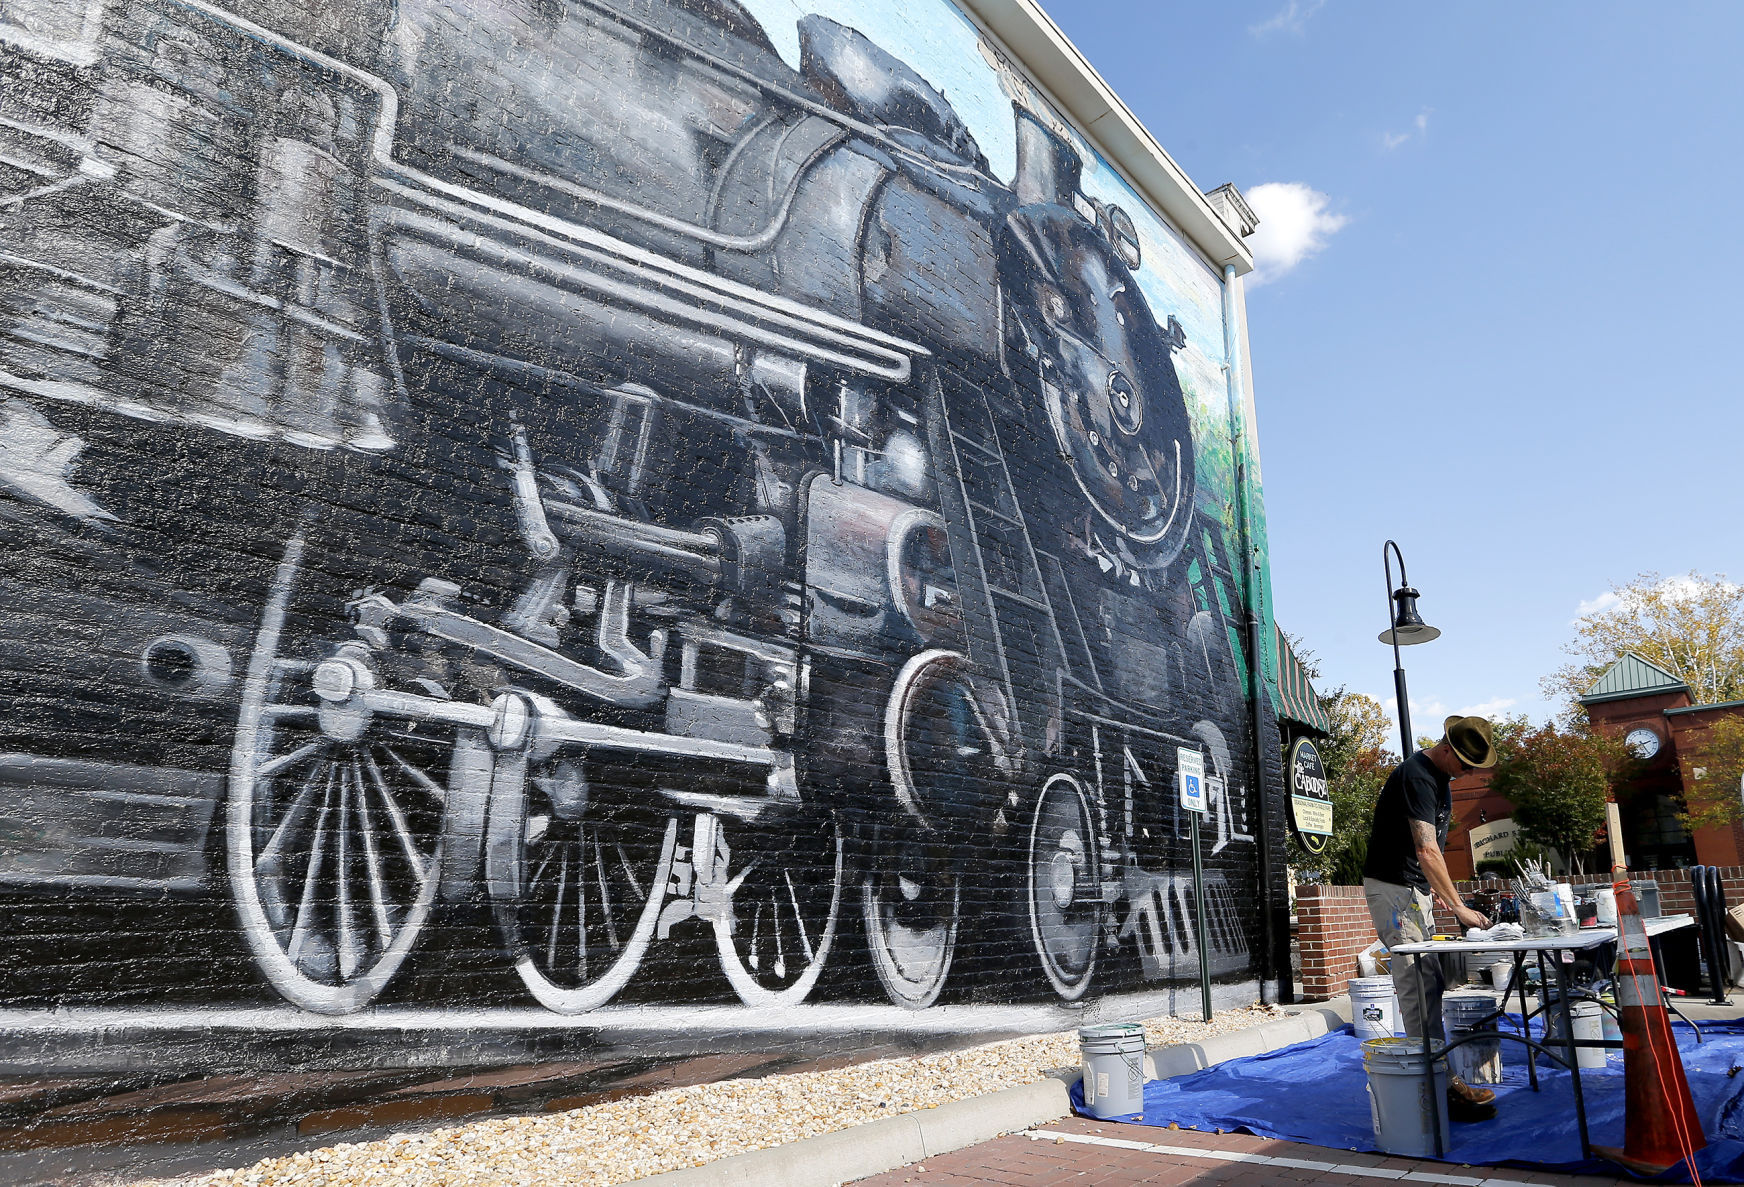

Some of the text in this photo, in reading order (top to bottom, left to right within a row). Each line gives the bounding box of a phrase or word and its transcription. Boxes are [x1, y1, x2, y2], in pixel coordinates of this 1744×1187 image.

[1179, 753, 1202, 766] RESERVED
[1299, 750, 1317, 762] MARKET
[1181, 763, 1201, 776] PARKING
[1295, 772, 1327, 797] CABOOSE
[1187, 797, 1201, 808] ONLY
[1474, 831, 1509, 848] RICHARD
